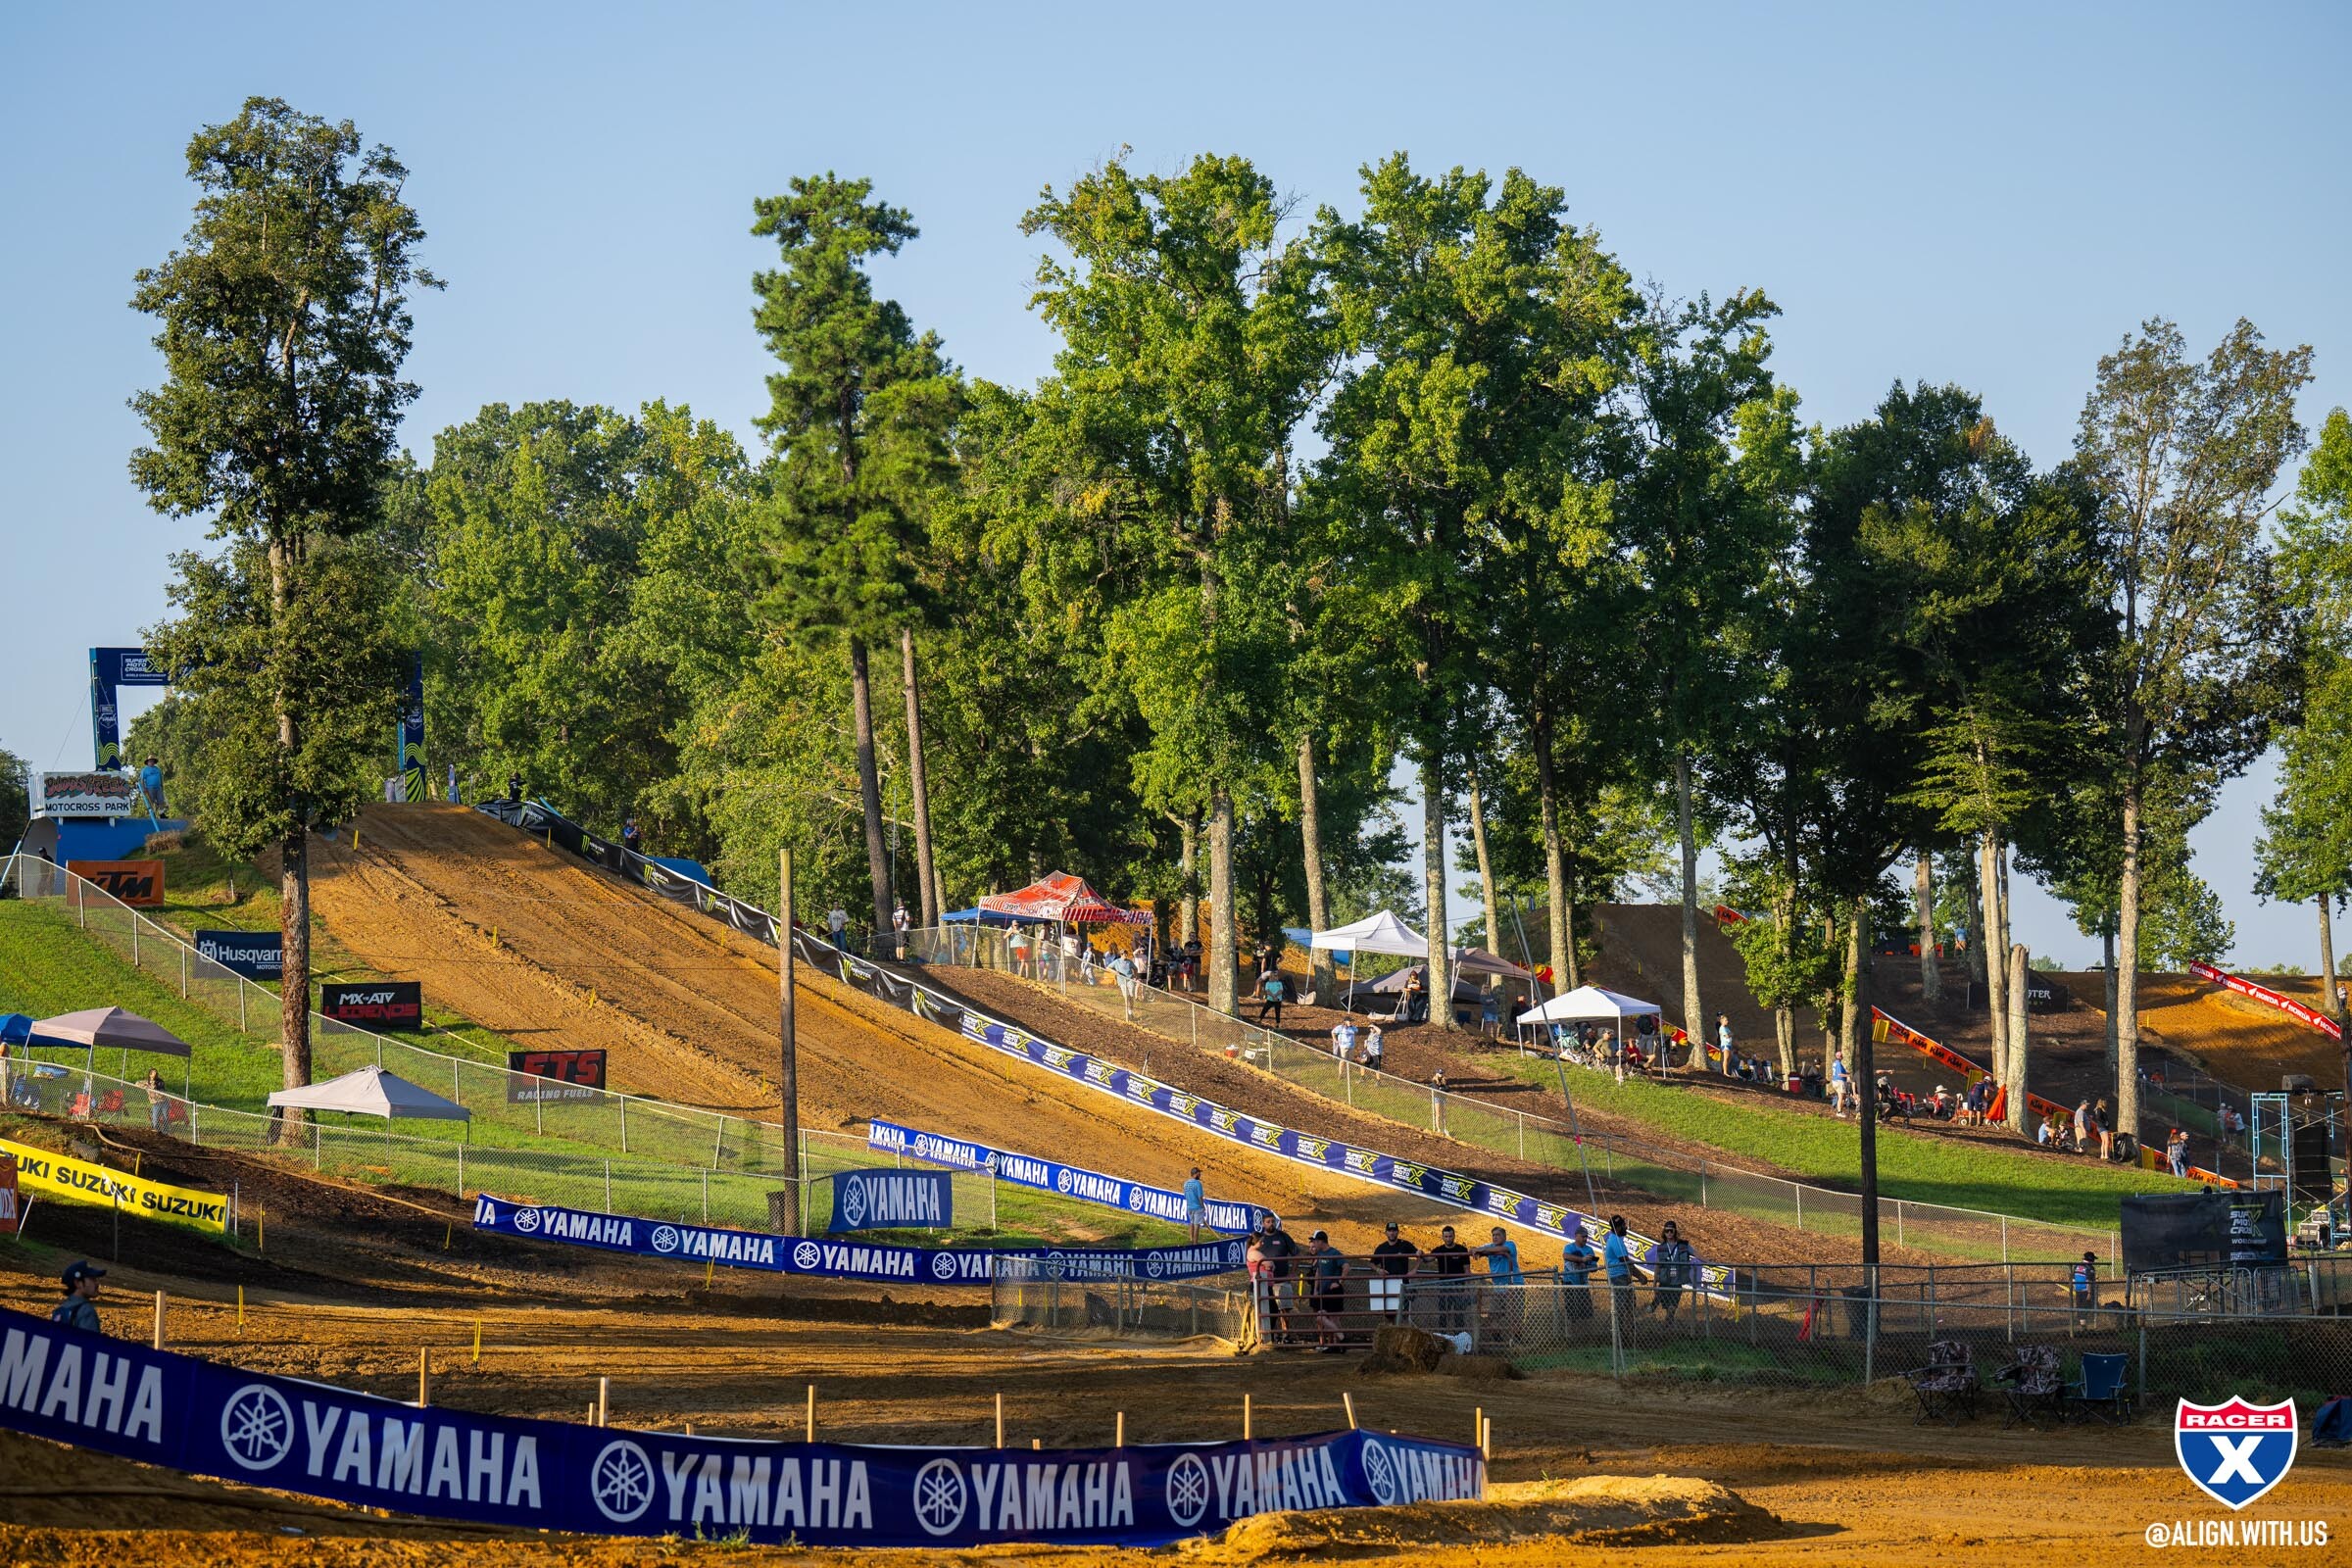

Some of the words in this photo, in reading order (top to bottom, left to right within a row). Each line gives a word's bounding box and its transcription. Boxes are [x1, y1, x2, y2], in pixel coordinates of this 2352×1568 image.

[46, 803, 100, 811] MOTOCROSS
[105, 803, 129, 811] PARK
[80, 871, 154, 899] KTM
[324, 1003, 418, 1019] LEGENDS
[339, 993, 364, 1005] MX
[368, 992, 395, 1004] ATV
[2255, 992, 2279, 1006] HONDA
[2288, 1004, 2311, 1022] HONDA
[523, 1052, 601, 1086] ETS
[56, 1166, 136, 1203] SUZUKI
[141, 1192, 225, 1223] SUZUKI
[866, 1177, 940, 1221] YAMAHA
[928, 1137, 976, 1168] YAMAHA
[1000, 1155, 1049, 1186] YAMAHA
[1073, 1173, 1120, 1204] YAMAHA
[1144, 1190, 1188, 1221] YAMAHA
[1206, 1203, 1247, 1229] YAMAHA
[542, 1210, 632, 1247] YAMAHA
[681, 1229, 774, 1264] YAMAHA
[823, 1246, 914, 1276] YAMAHA
[958, 1254, 1039, 1277] YAMAHA
[1067, 1254, 1136, 1277] YAMAHA
[1164, 1247, 1220, 1274] YAMAHA
[0, 1327, 164, 1444] MAHA
[303, 1399, 542, 1509] YAMAHA
[662, 1451, 873, 1529] YAMAHA
[971, 1461, 1134, 1530] YAMAHA
[1211, 1445, 1347, 1519] YAMAHA
[1389, 1446, 1484, 1504] YAMAHA
